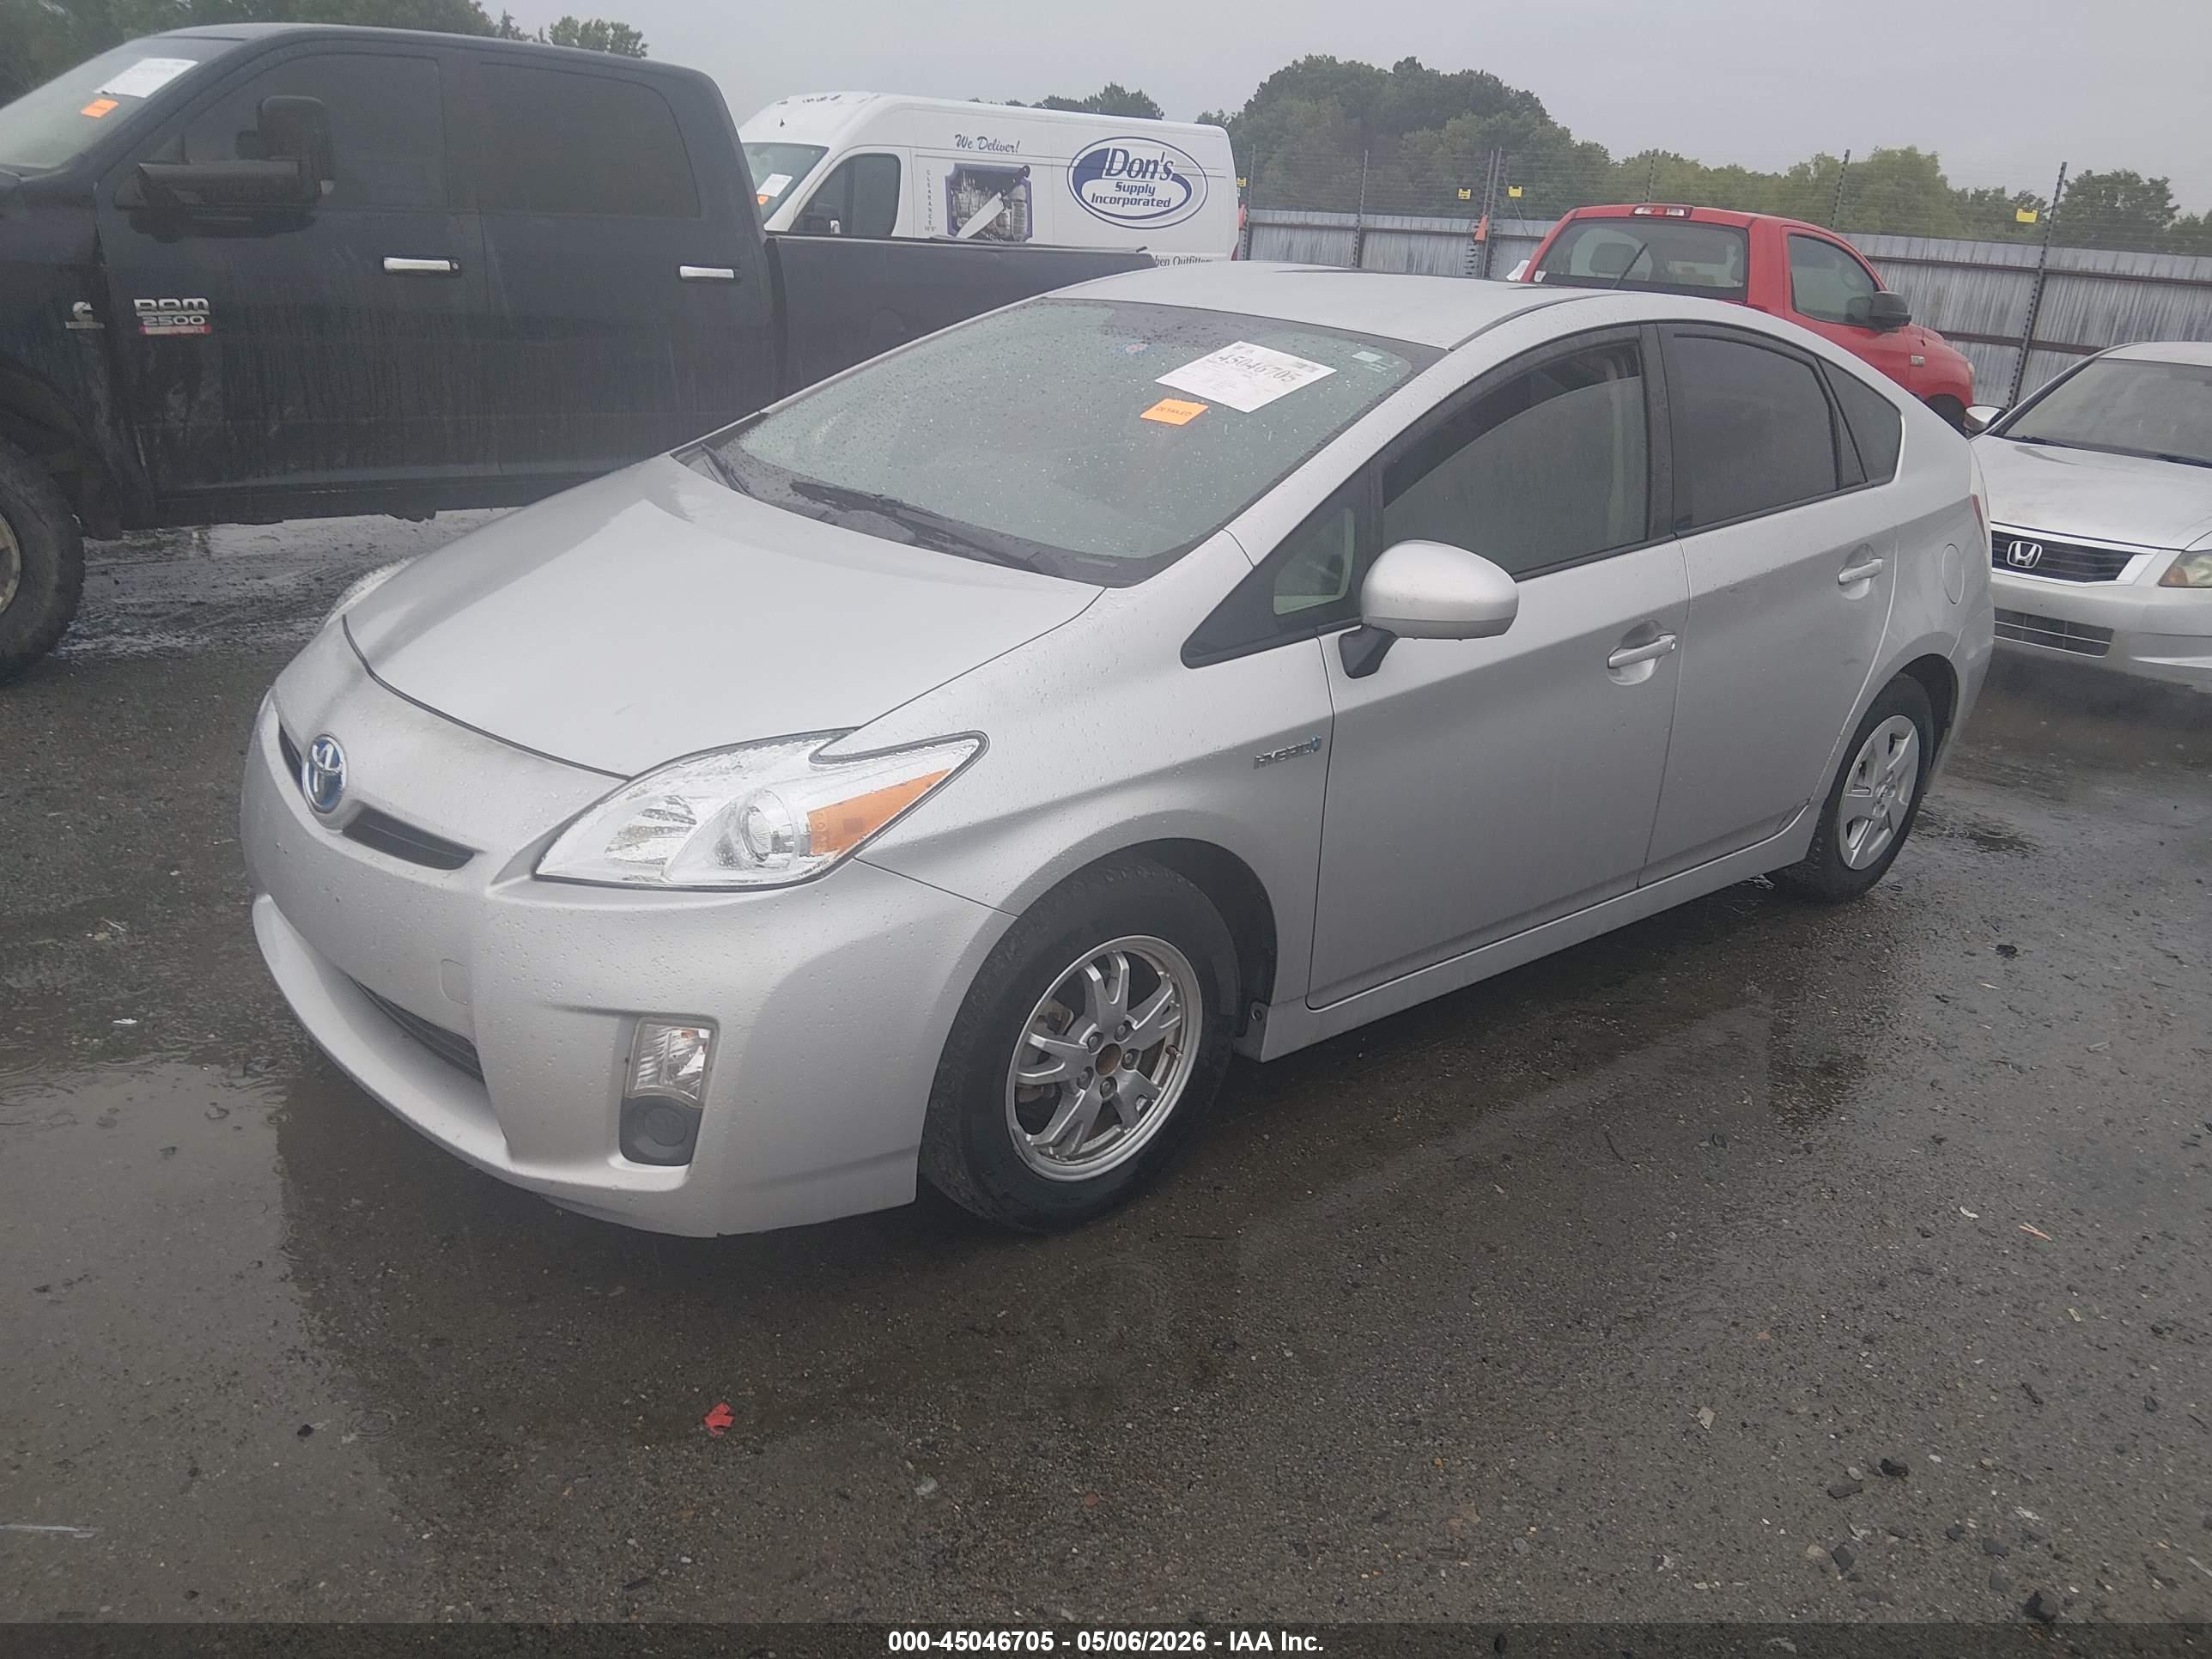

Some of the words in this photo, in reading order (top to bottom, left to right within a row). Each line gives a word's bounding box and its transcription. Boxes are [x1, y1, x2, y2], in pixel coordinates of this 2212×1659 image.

[955, 134, 973, 149] We
[977, 136, 1021, 153] Deliver!
[1104, 148, 1175, 180] Don's
[1115, 181, 1156, 197] Supply
[1091, 192, 1172, 208] Incorporated
[1154, 255, 1170, 267] hen
[143, 315, 206, 326] 2500
[1218, 354, 1304, 383] 45046705
